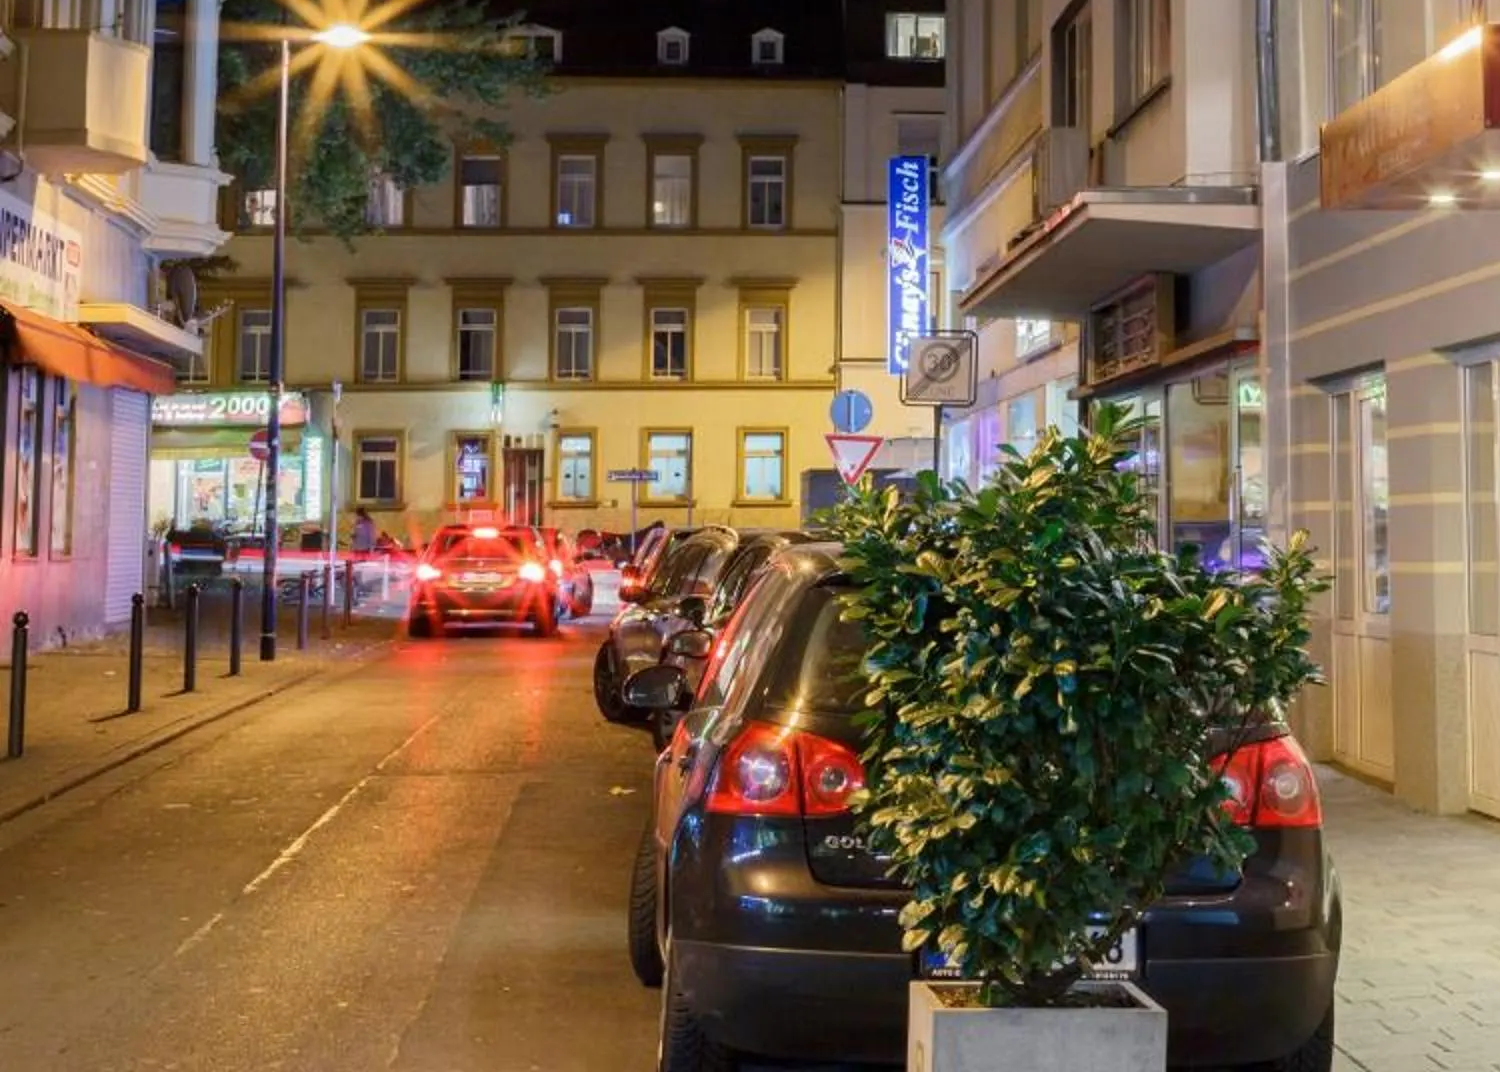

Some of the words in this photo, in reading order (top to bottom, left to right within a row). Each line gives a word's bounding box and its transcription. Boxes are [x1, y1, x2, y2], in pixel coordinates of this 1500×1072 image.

[896, 162, 919, 234] Fisch
[208, 397, 270, 419] 2000
[825, 835, 866, 849] GOL
